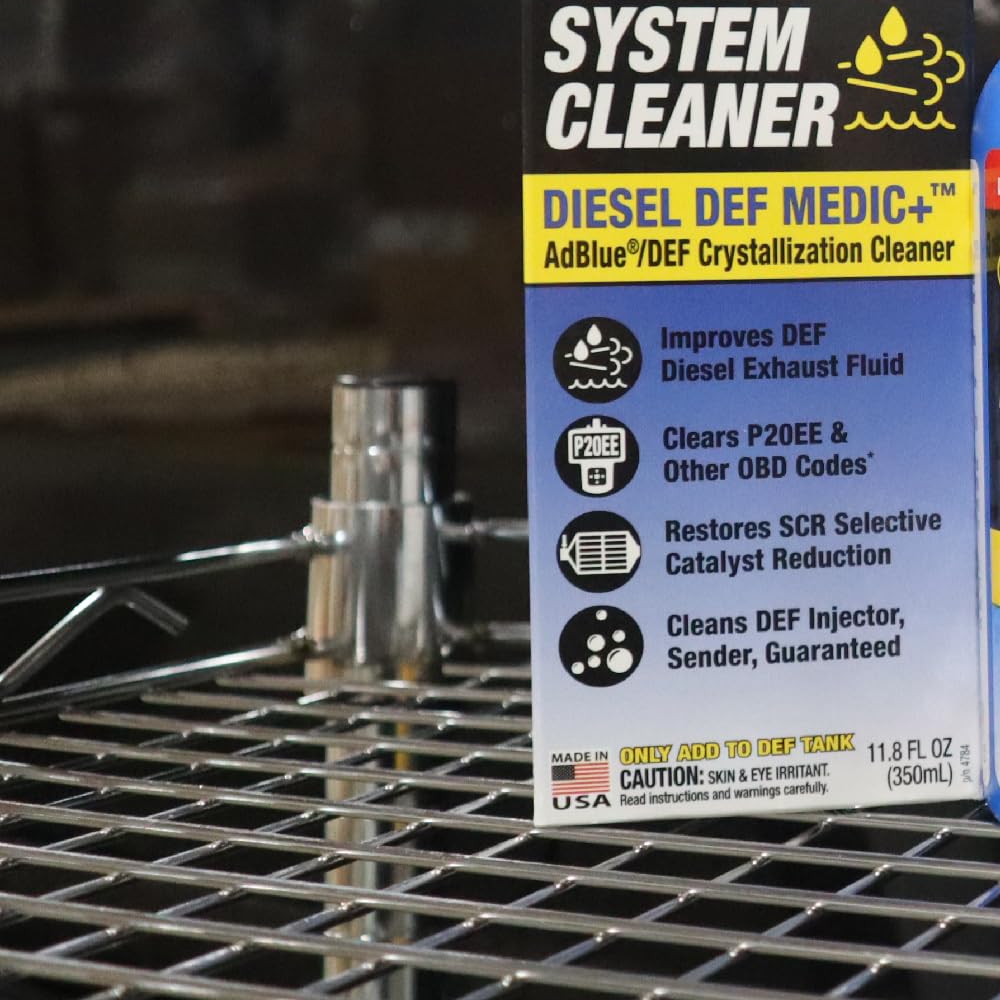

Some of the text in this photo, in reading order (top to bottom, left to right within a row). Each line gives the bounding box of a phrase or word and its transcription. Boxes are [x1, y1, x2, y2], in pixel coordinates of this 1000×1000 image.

[544, 5, 810, 72] SYSTEM
[546, 82, 839, 149] CLEANER
[544, 188, 681, 229] DIESEL
[696, 186, 768, 227] DEF
[698, 236, 863, 270] Crystallization
[870, 235, 954, 263] Cleaner
[661, 323, 826, 352] Improves DEF
[662, 352, 904, 382] Diesel Exhaust Fluid
[574, 434, 620, 458] P20EE
[663, 421, 848, 450] Clears P20EE &
[664, 458, 729, 482] Other
[738, 455, 787, 480] OBD
[665, 509, 941, 542] Restores SCR Selective
[666, 544, 891, 577] Catalyst Reduction
[667, 605, 905, 637] Cleans DEF Injector,
[668, 635, 901, 669] Sender, Guaranteed
[551, 751, 608, 763] MADE IN
[619, 733, 856, 765] ONLY ADD TO DEF TANK
[867, 737, 953, 763] 11.8 FL OZ
[960, 744, 970, 767] 4784
[620, 763, 830, 790] CAUTION: SKIN & EYE IRRITANT.
[887, 763, 953, 791] (350mL)
[552, 794, 611, 810] USA
[620, 782, 829, 806] Read instructions and warnings carefully.
